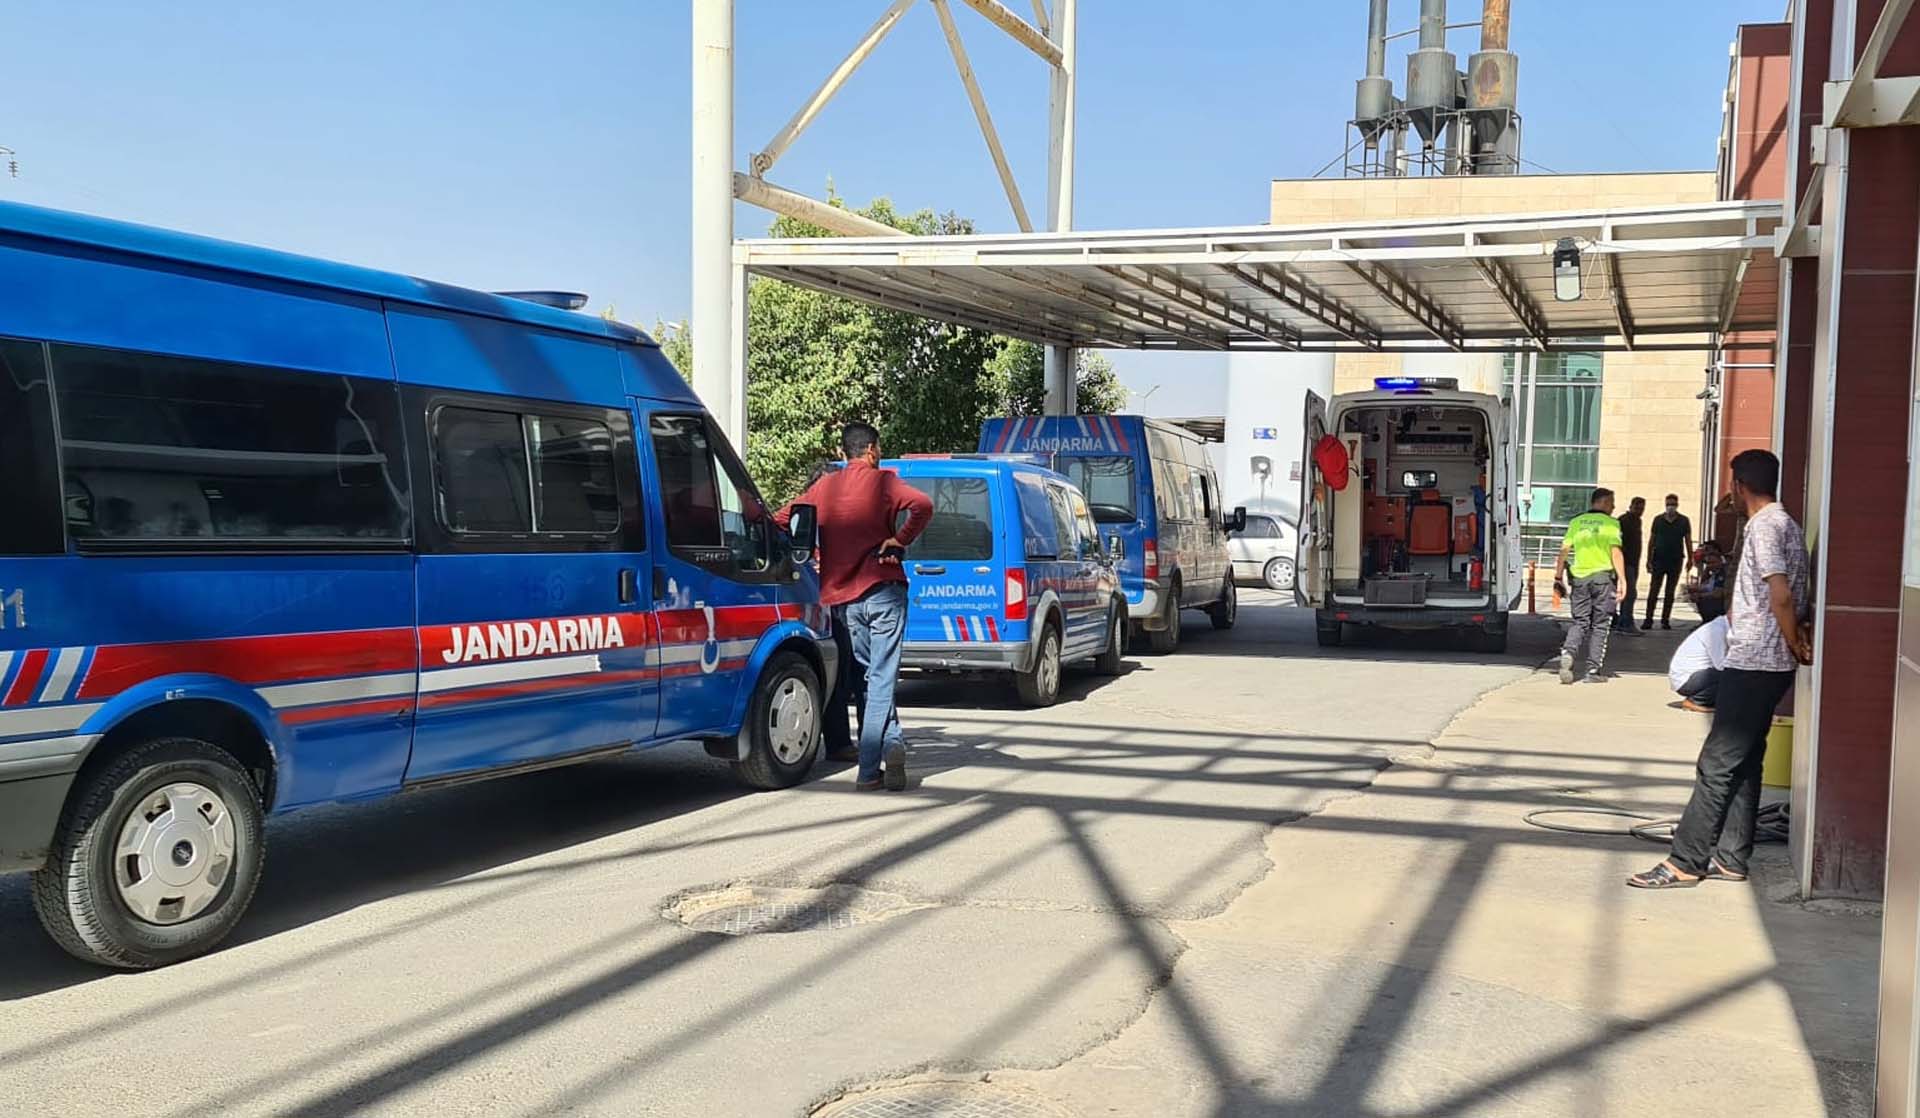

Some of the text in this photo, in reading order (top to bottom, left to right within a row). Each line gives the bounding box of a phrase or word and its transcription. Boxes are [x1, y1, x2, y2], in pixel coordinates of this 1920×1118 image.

[1022, 437, 1104, 451] JANDARMA
[918, 584, 997, 598] JANDARMA
[442, 616, 625, 663] JANDARMA
